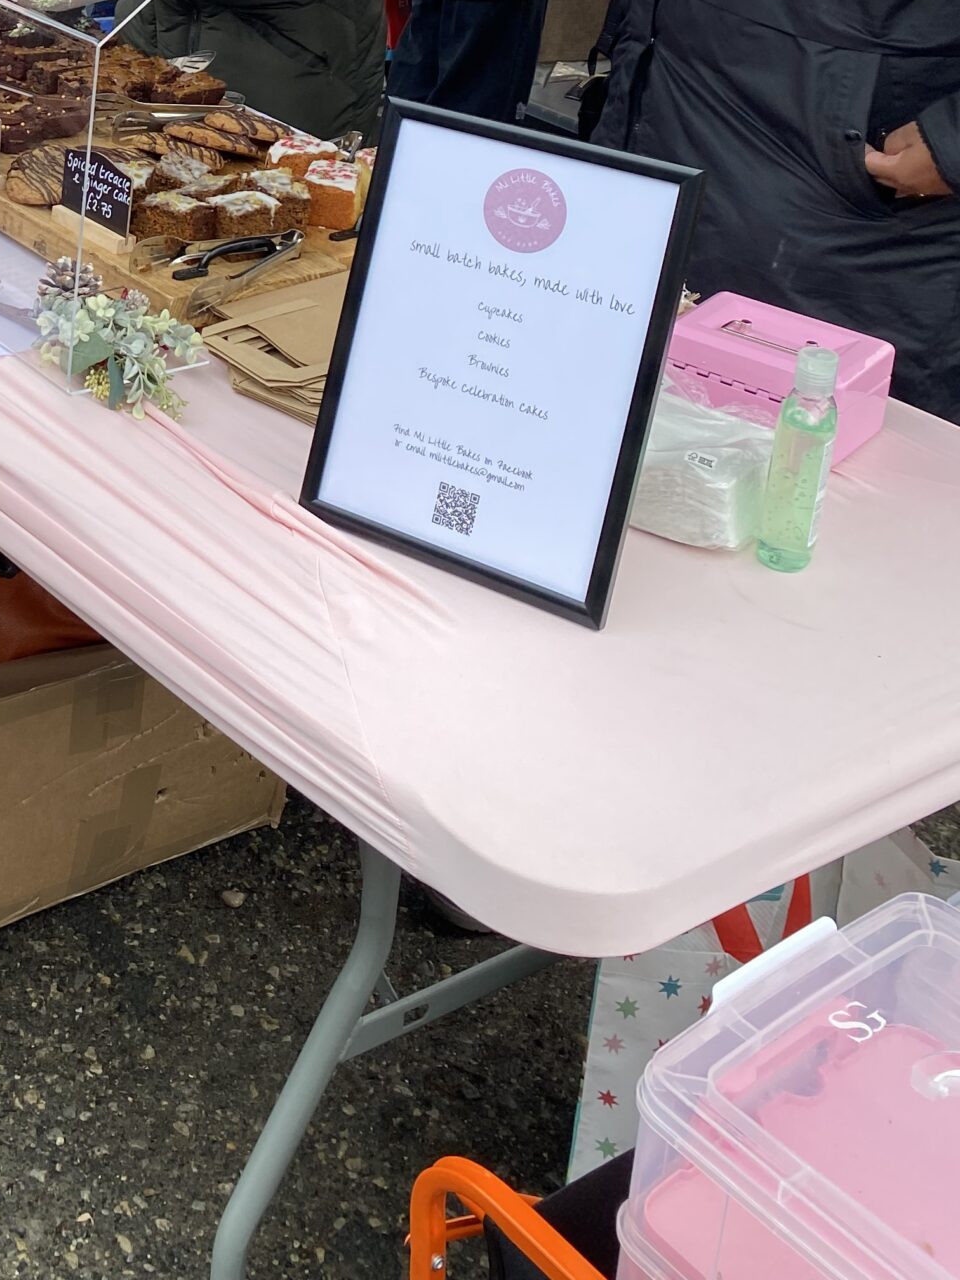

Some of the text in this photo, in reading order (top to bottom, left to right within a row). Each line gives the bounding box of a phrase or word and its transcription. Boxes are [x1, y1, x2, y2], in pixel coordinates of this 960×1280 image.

[99, 164, 131, 192] treacle
[410, 239, 636, 316] small batch bakes, made with love
[419, 366, 458, 390] Bespoke
[467, 354, 510, 378] Brownies
[393, 423, 411, 437] Find
[428, 437, 452, 452] Little
[456, 444, 482, 462] Bakes
[497, 459, 535, 482] Facebook
[405, 442, 426, 457] email
